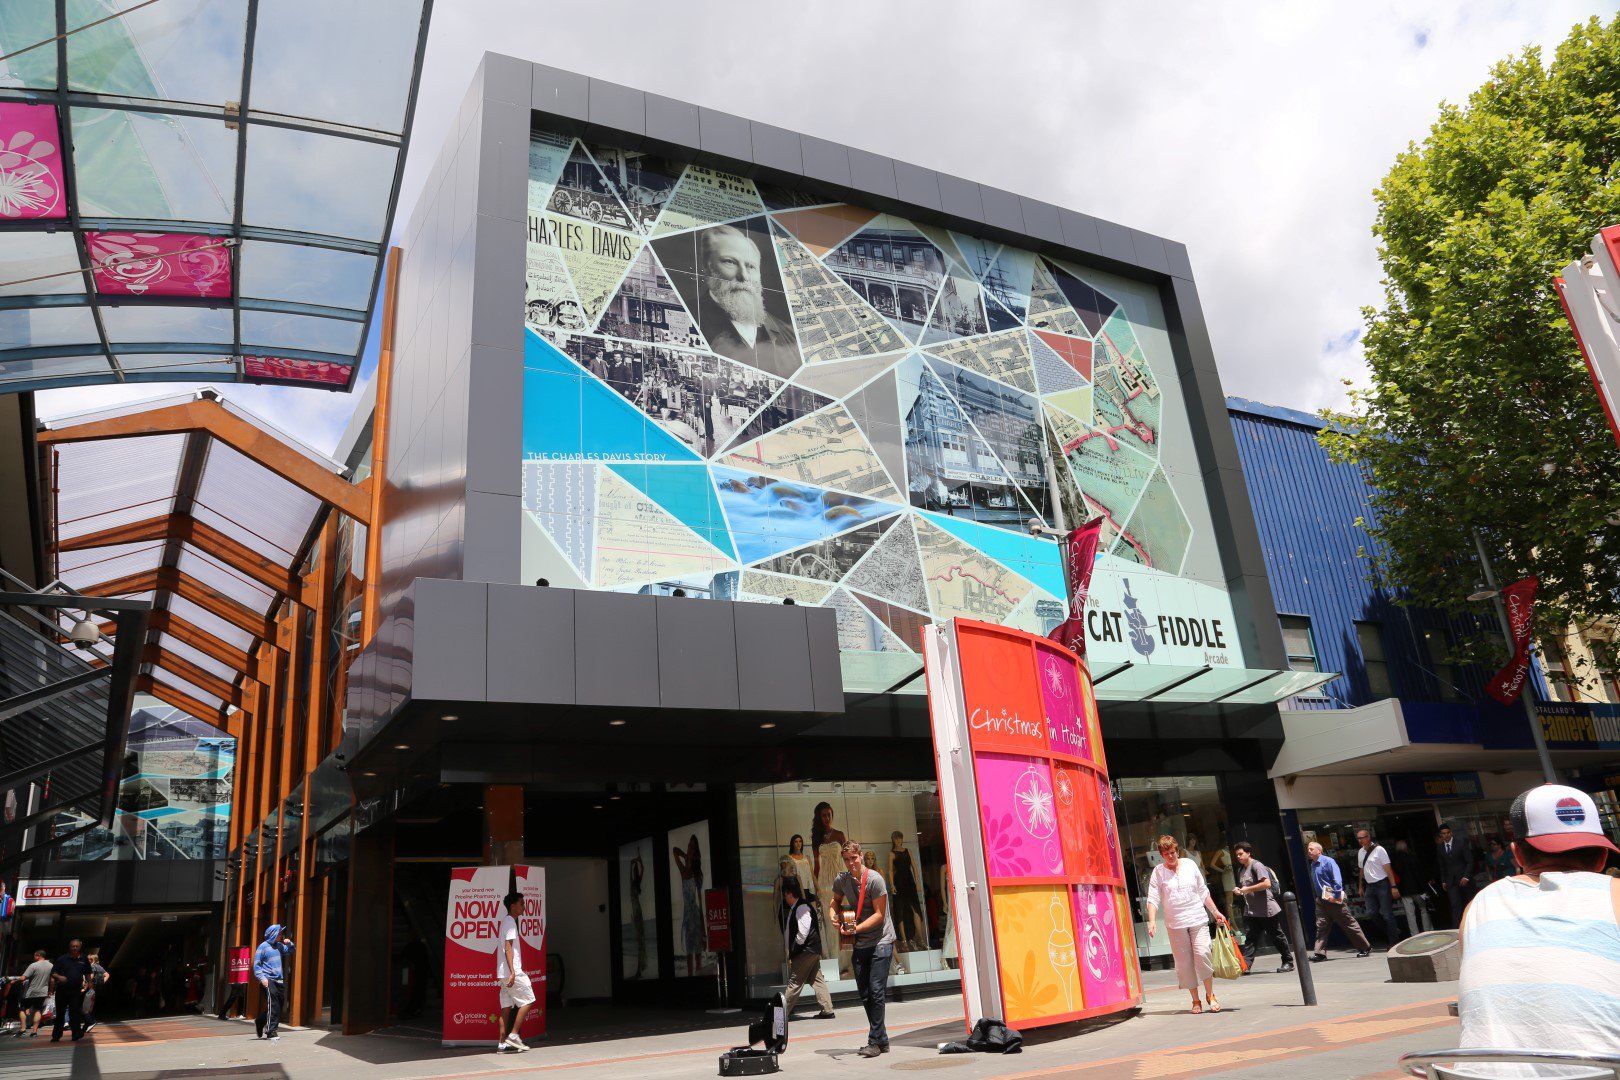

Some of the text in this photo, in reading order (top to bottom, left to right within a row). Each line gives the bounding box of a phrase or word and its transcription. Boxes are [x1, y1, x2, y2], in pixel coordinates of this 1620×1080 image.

[592, 226, 632, 261] DAVIS
[528, 452, 666, 461] THE CHARLES DAVIS STORY
[970, 473, 1002, 482] CHARLES
[1088, 610, 1226, 649] CAT FIDDLE
[1204, 652, 1229, 664] Arcade
[1535, 706, 1576, 714] STALLARD'S
[970, 708, 1042, 739] Christmas
[1060, 723, 1087, 750] Hobart
[27, 888, 68, 896] LOWES
[454, 900, 500, 919] NOW
[709, 908, 727, 920] SALE
[450, 921, 501, 939] OPEN
[521, 918, 543, 936] OPEN
